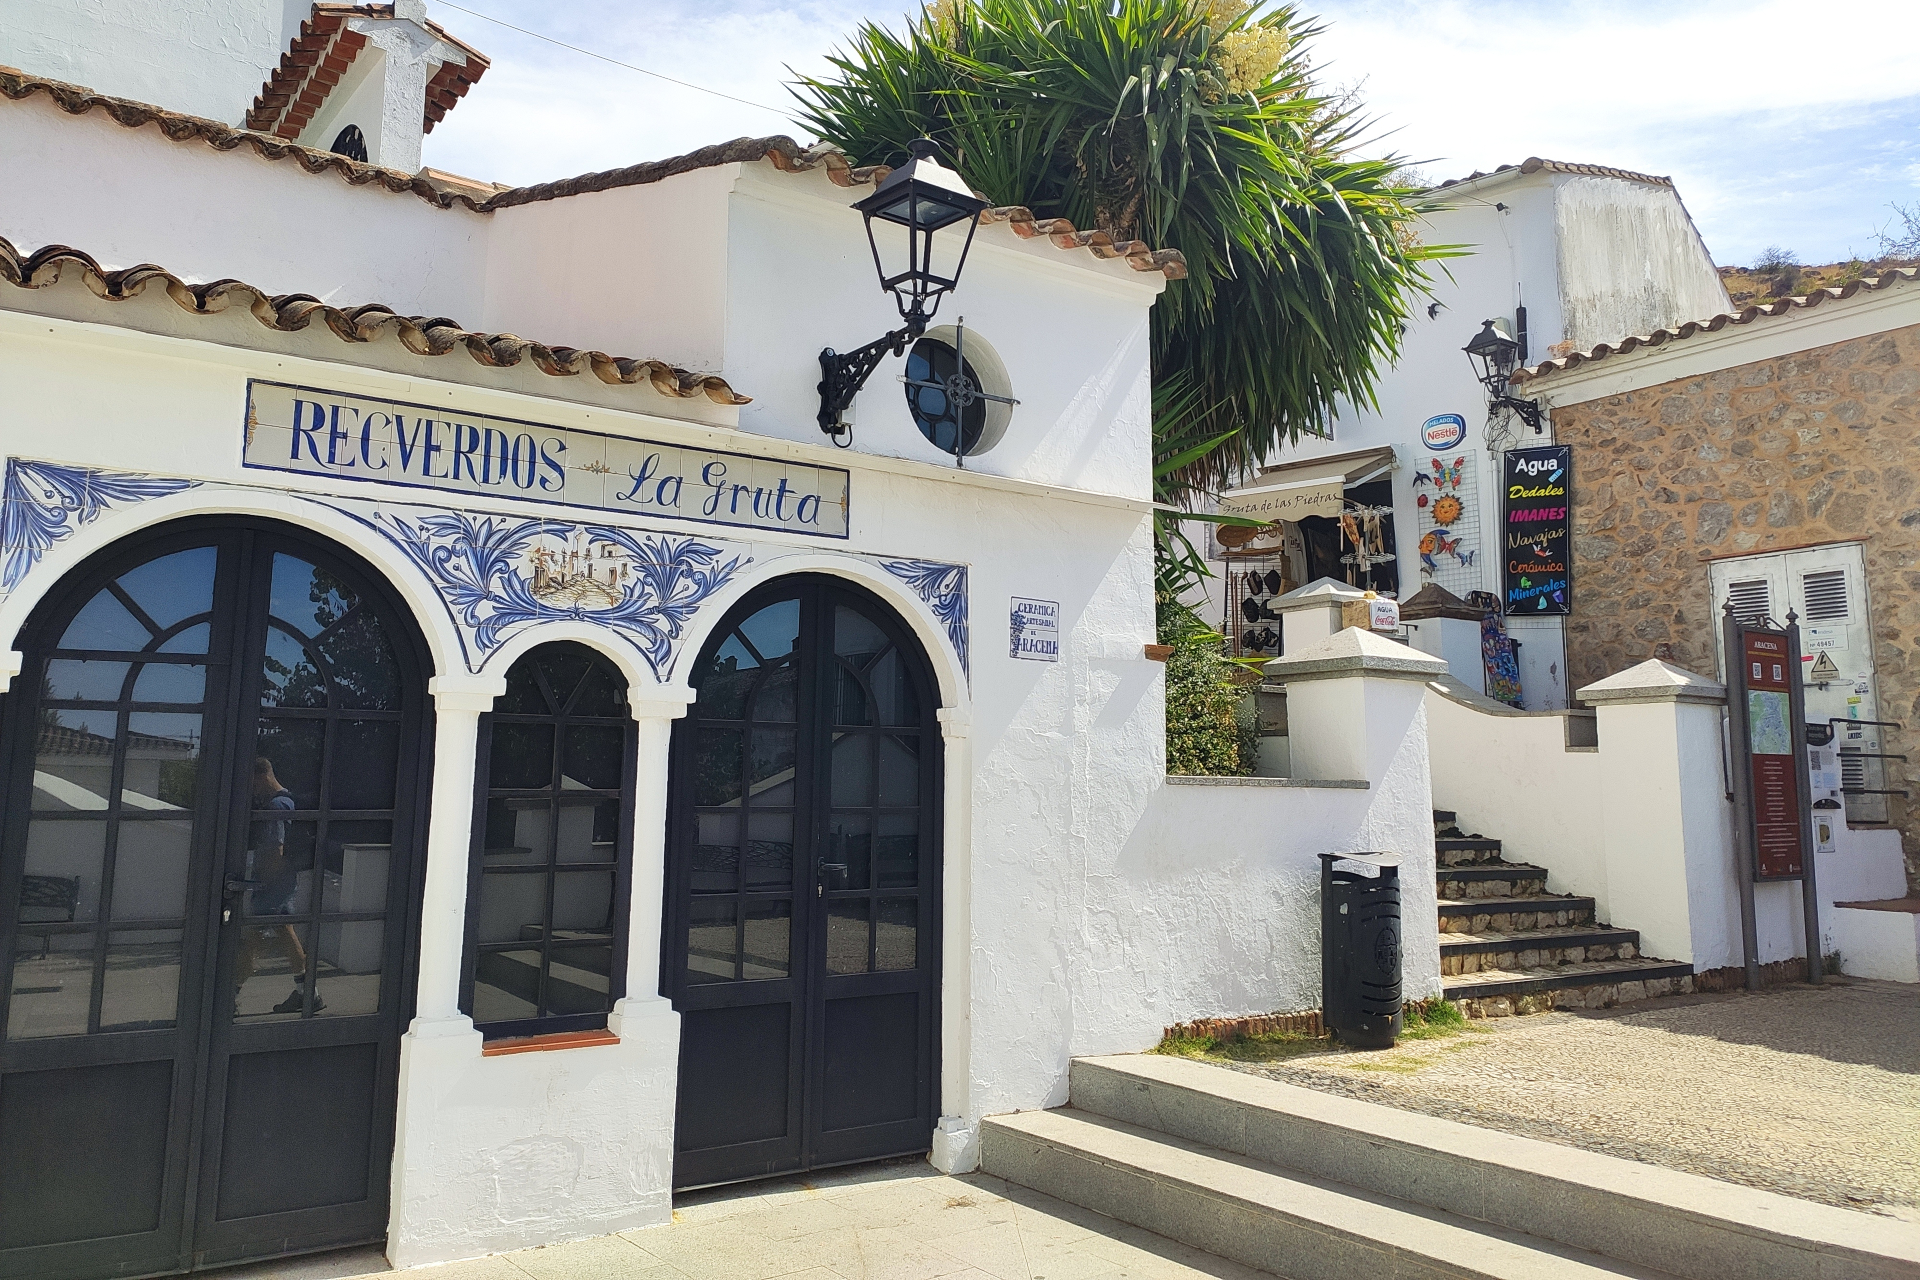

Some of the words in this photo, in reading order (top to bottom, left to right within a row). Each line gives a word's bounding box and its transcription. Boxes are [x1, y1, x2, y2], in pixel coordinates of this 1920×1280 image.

[1429, 417, 1454, 426] HELADOS
[1427, 426, 1458, 441] Nestlé
[1515, 458, 1558, 476] Agua
[616, 453, 683, 508] La
[701, 460, 821, 525] Gruta
[1509, 484, 1565, 498] Dedales
[1222, 503, 1258, 515] Gruta
[1261, 500, 1272, 513] de
[1275, 498, 1291, 509] las
[1294, 492, 1337, 508] Piedras
[1509, 507, 1566, 522] IMANES
[1508, 528, 1566, 549] Navajas
[1509, 560, 1565, 574] Cerámica
[1509, 579, 1566, 602] Minerales
[1018, 602, 1056, 617] CERAMICA
[1026, 617, 1055, 628] ARTESANAL
[1017, 637, 1058, 655] ARACENA
[1753, 641, 1778, 650] ARACENA
